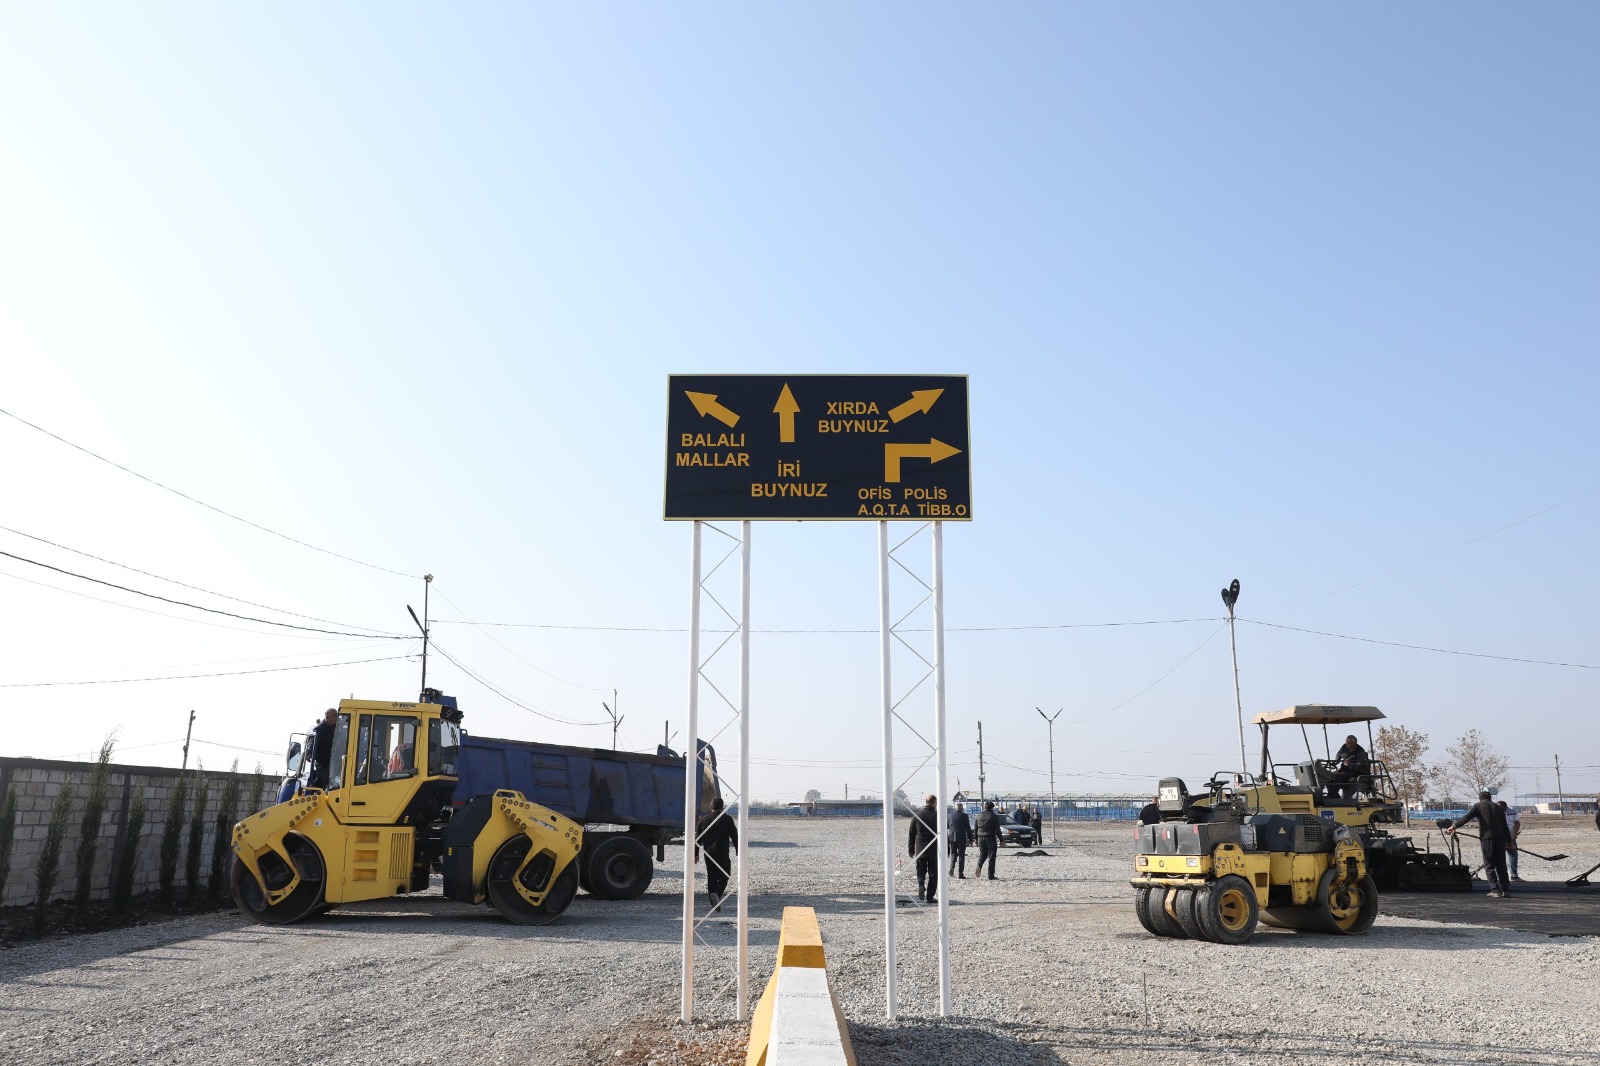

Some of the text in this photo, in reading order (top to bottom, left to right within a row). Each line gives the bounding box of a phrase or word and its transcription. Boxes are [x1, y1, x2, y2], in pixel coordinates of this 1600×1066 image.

[827, 402, 879, 415] XIRDA
[818, 420, 889, 433] BUYNUZ
[681, 433, 745, 447] BALALI
[676, 453, 750, 467] MALLAR
[777, 460, 801, 477] İRİ
[751, 483, 828, 497] BUYNUZ
[858, 486, 947, 500] OFİS POLİS
[858, 502, 967, 517] A.Q.T.A TİBB.O
